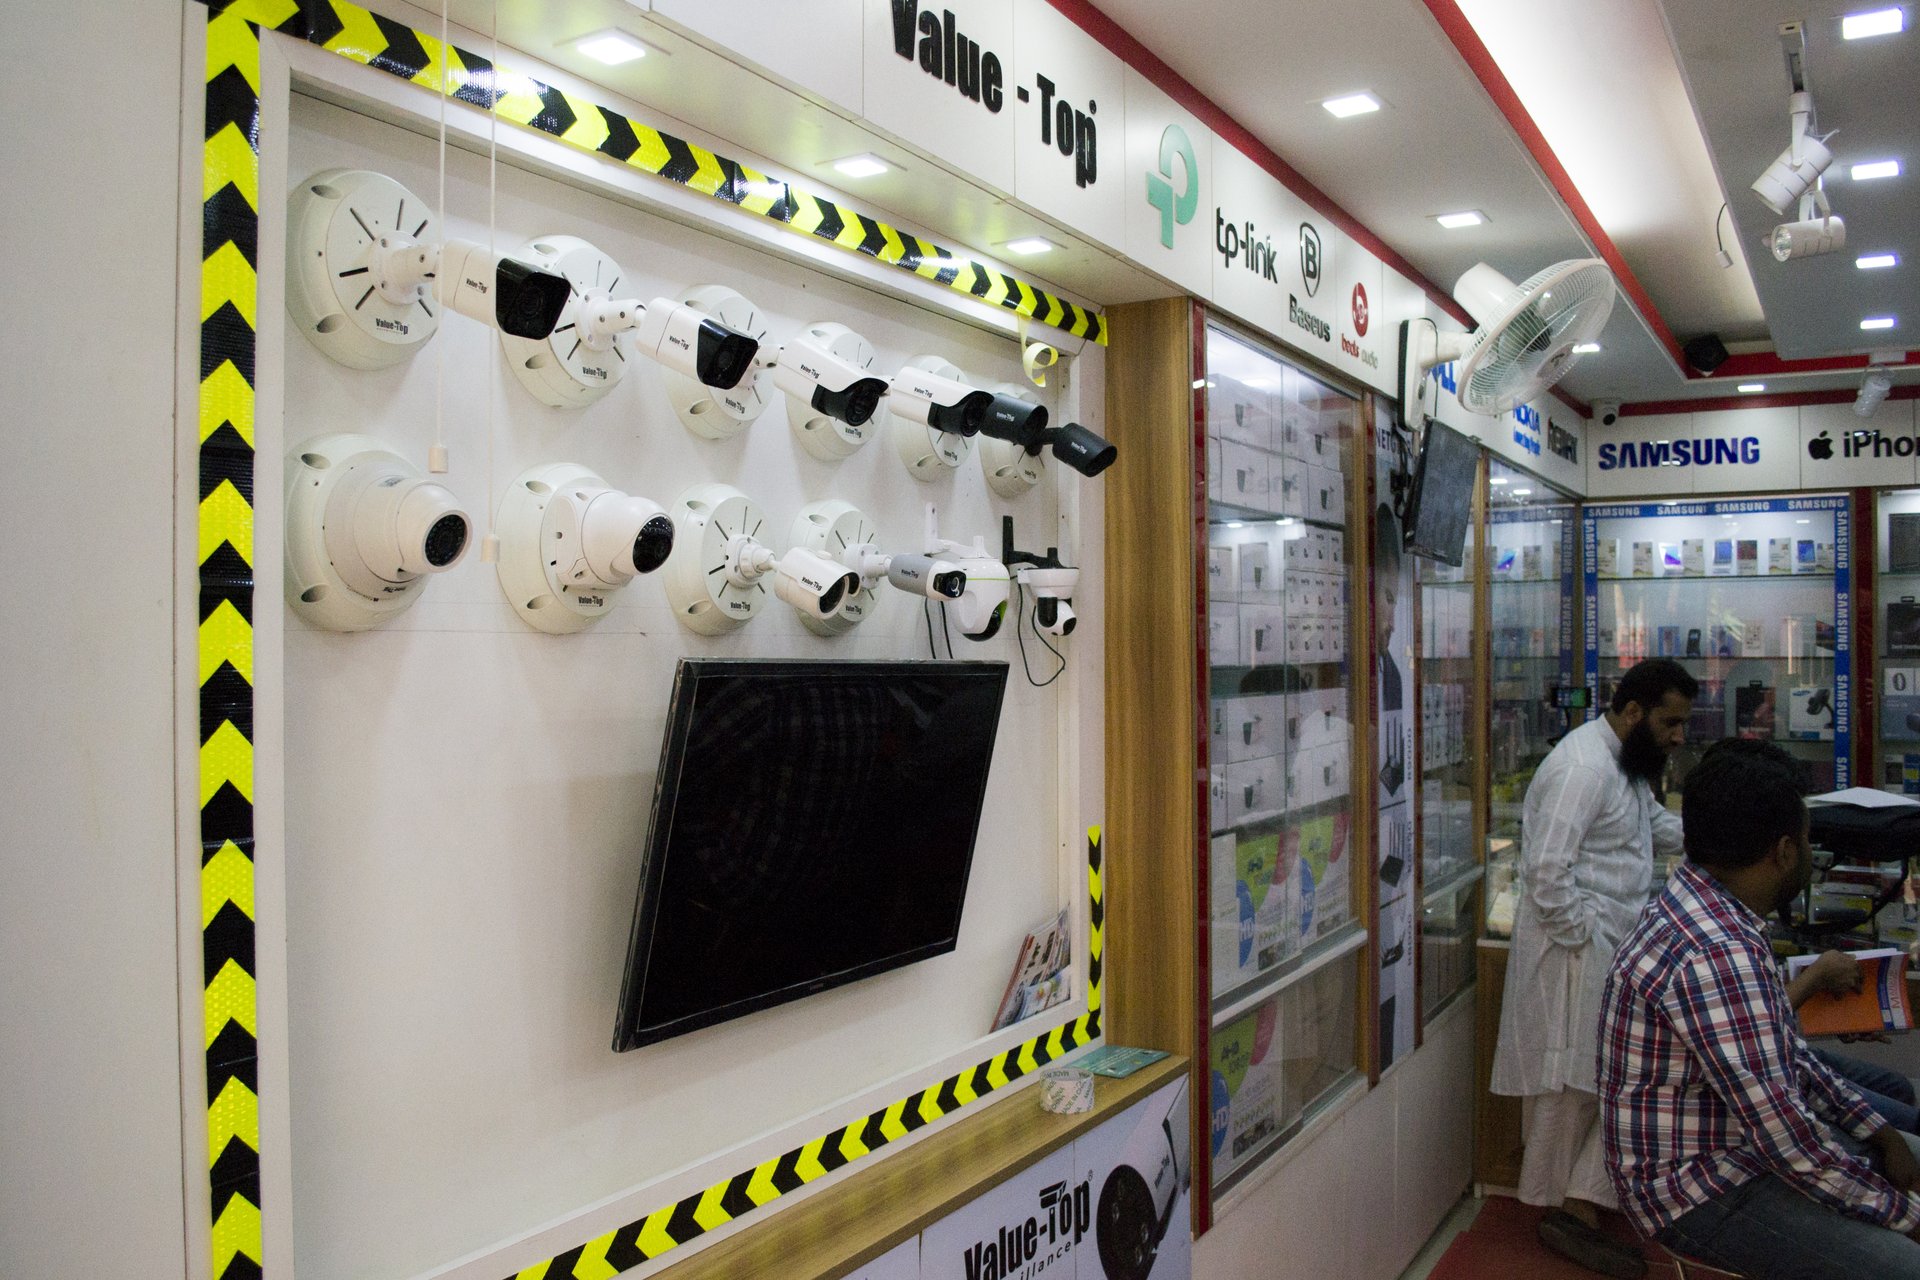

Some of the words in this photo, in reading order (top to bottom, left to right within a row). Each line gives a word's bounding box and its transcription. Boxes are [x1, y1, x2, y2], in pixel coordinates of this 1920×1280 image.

[891, 0, 1003, 114] Value
[1036, 73, 1098, 189] Top
[1216, 207, 1278, 284] tp-link
[466, 278, 488, 294] Value-Top
[375, 318, 409, 335] Value-Top
[1289, 293, 1331, 342] Baseus
[582, 366, 607, 380] Value-Top
[1598, 436, 1760, 471] SAMSUNG
[1843, 430, 1920, 458] iPho
[1588, 507, 1640, 517] SAMSUNG
[1657, 504, 1706, 515] SAMSUN
[1715, 501, 1770, 512] SAMSUNG
[1788, 499, 1845, 510] SAMSUNG
[1584, 518, 1596, 574] SAMSUNG
[1837, 510, 1848, 569] SAMSUNG
[578, 595, 603, 607] Value-Top
[730, 601, 751, 612] Value-Top
[1837, 592, 1848, 651] SAMSUNG
[1586, 595, 1597, 651] SAMSUNG
[1837, 674, 1848, 734] SAMSUNG
[1837, 756, 1848, 790] SAMS
[964, 1180, 1090, 1280] Value-Top
